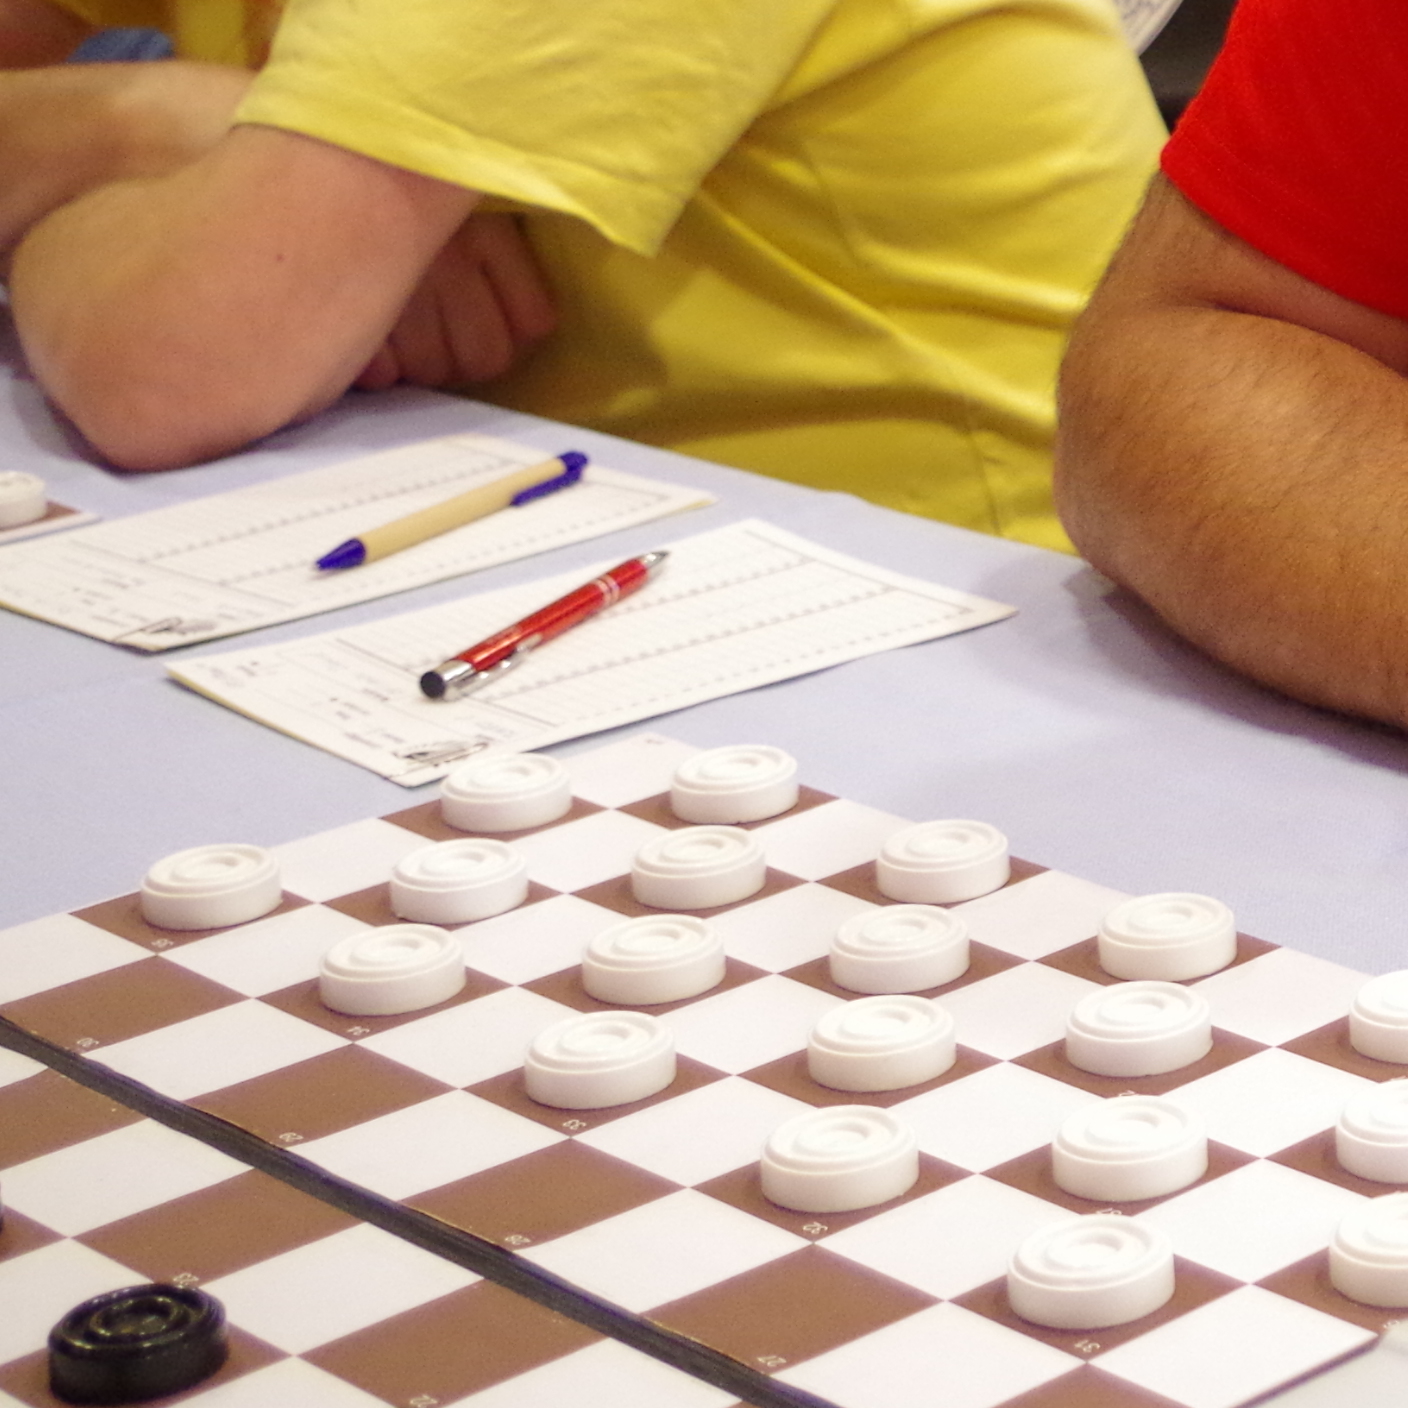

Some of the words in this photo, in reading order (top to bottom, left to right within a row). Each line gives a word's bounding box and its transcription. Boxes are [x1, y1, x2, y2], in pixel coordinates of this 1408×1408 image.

[347, 1025, 370, 1037] 34
[562, 1118, 587, 1131] 33
[279, 1132, 304, 1144] 29
[802, 1221, 828, 1235] 32
[1074, 1339, 1101, 1354] 31
[757, 1354, 787, 1368] 27
